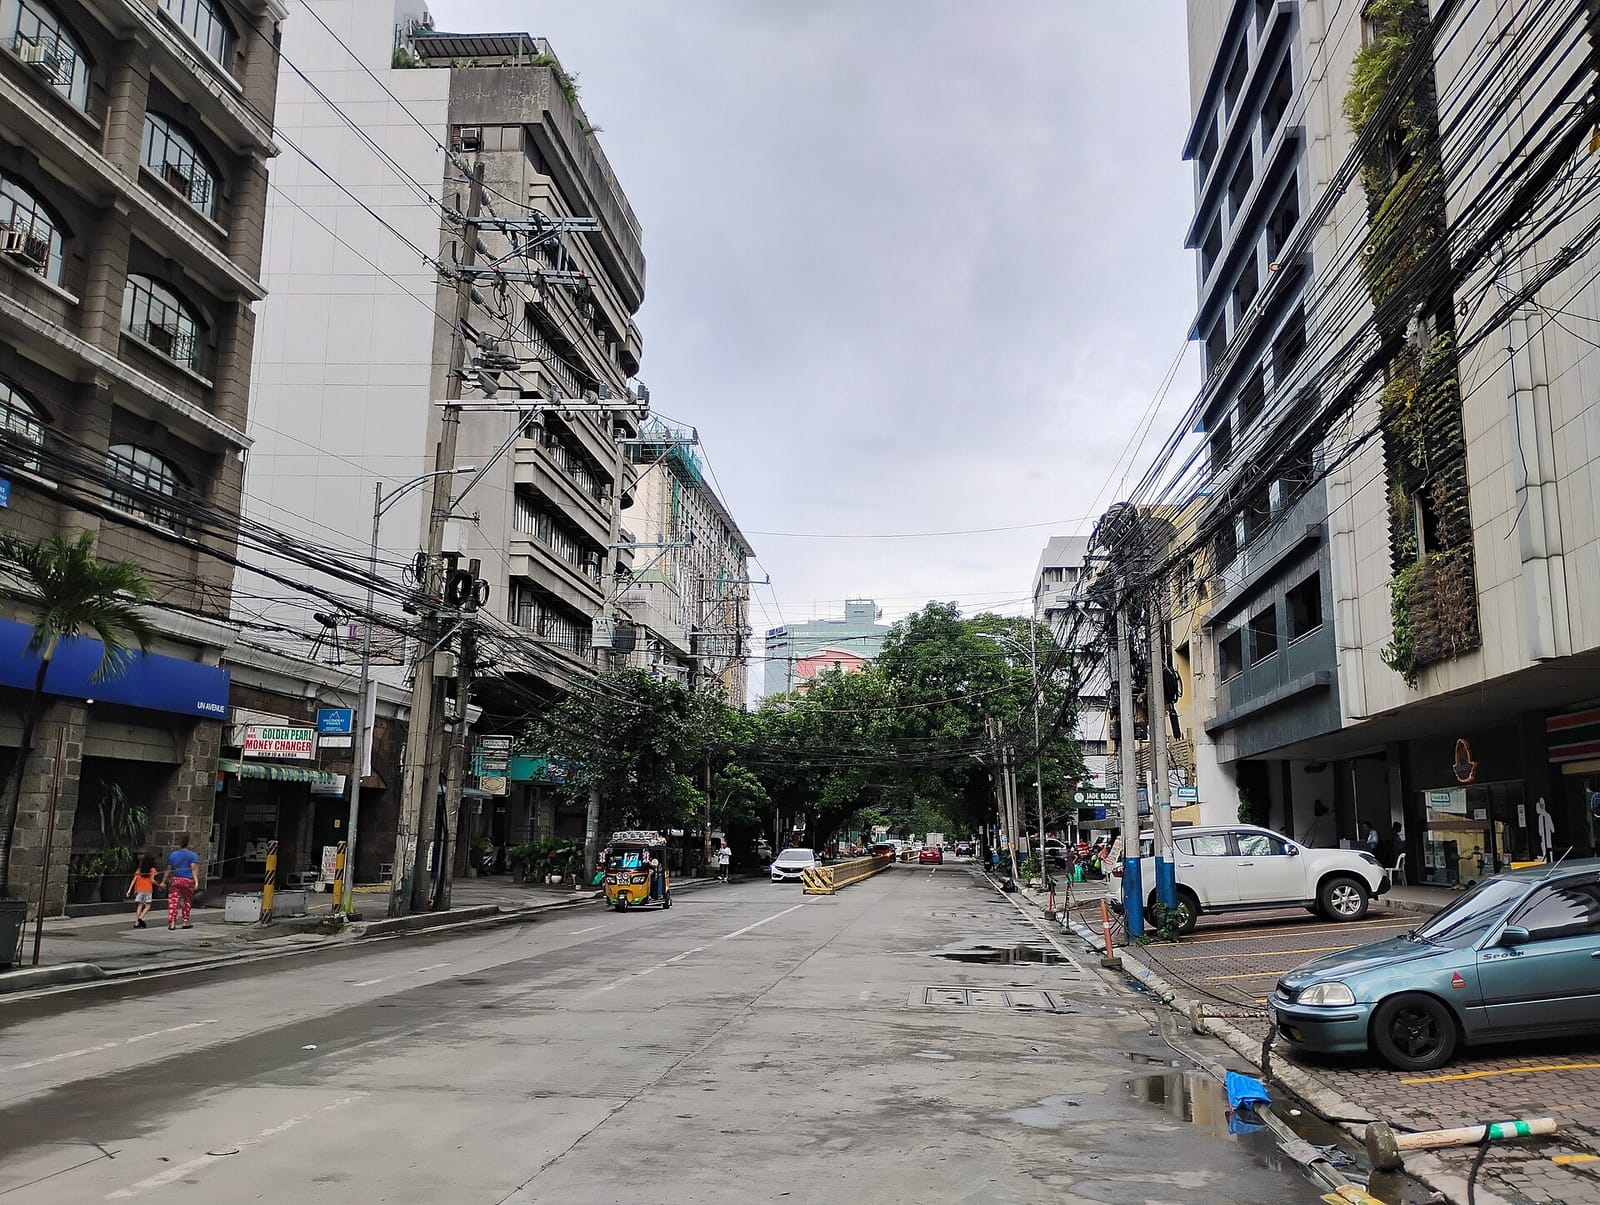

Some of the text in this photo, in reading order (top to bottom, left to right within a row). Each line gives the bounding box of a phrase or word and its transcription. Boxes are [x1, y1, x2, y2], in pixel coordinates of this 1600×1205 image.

[206, 703, 225, 713] AVENUE
[262, 728, 290, 740] GOLDEN
[290, 729, 313, 741] PEARL
[245, 740, 312, 752] MONEY CHANGER
[1086, 792, 1100, 800] JADE
